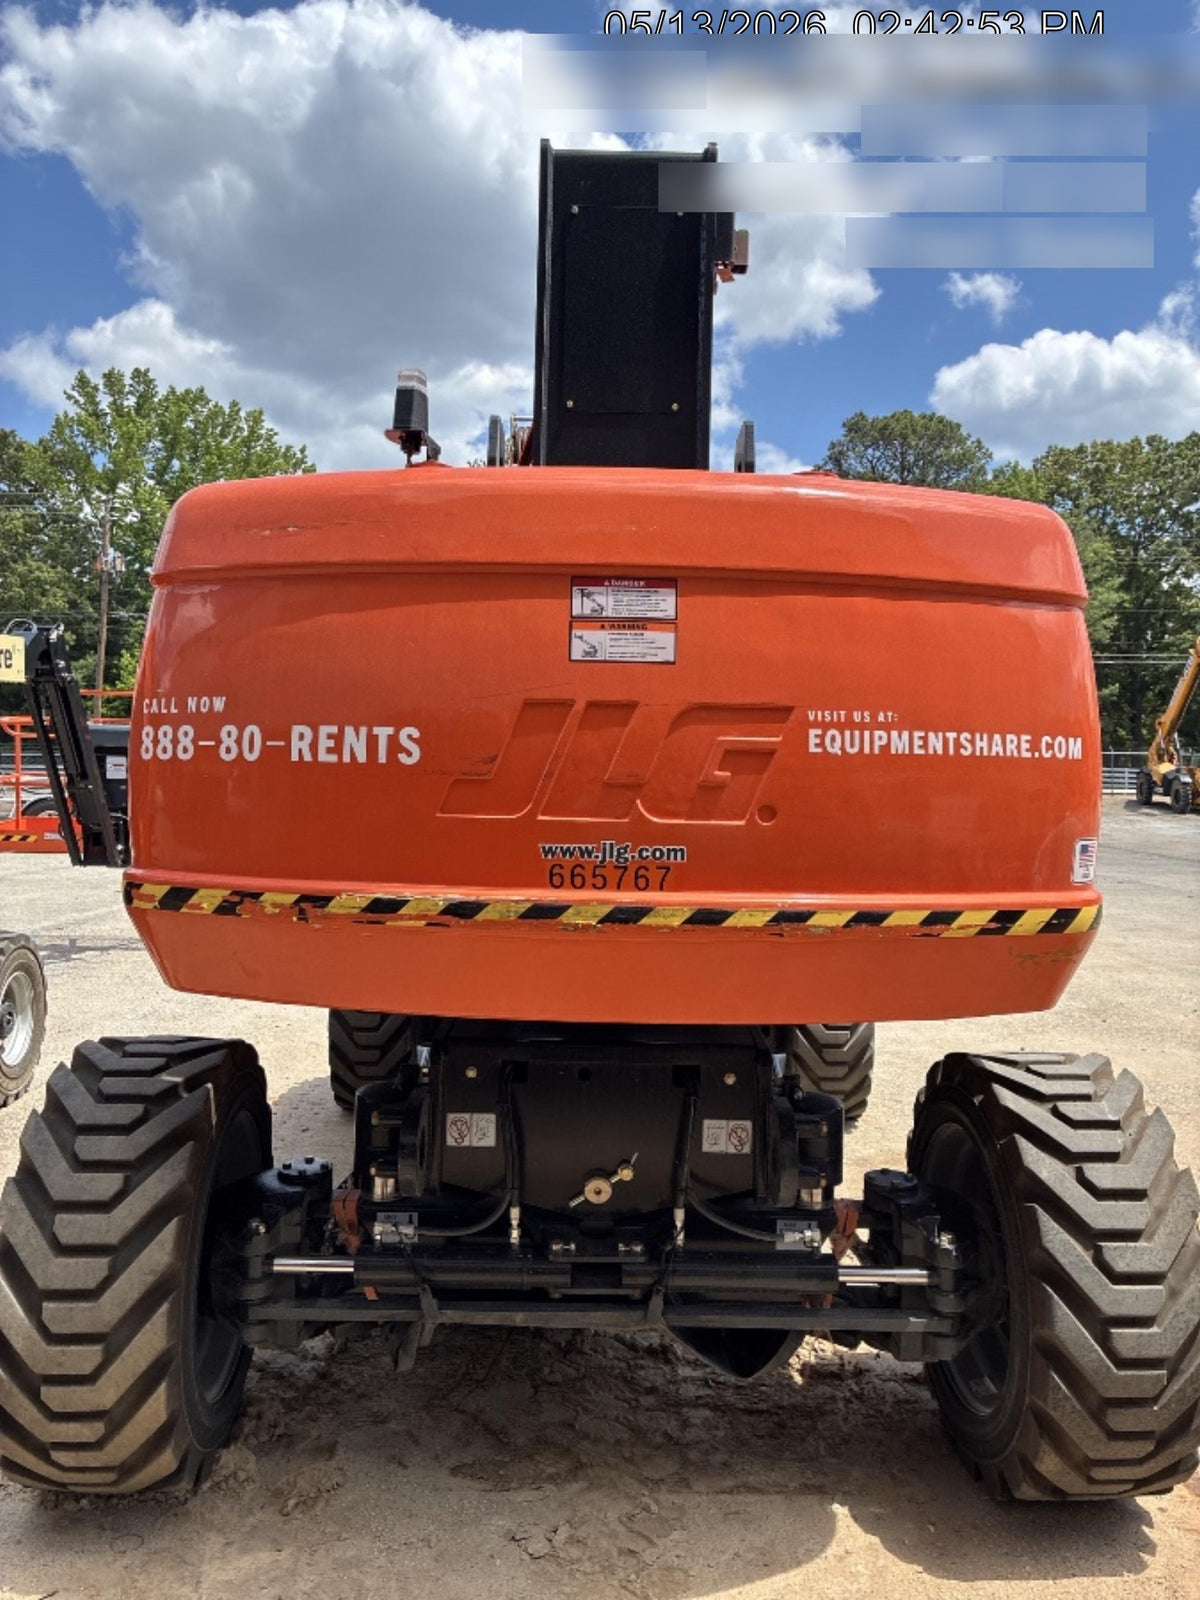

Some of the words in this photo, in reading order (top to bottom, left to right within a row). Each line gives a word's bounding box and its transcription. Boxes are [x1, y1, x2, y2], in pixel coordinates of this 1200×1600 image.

[143, 697, 178, 714] CALL
[187, 696, 226, 713] NOW
[808, 710, 847, 722] VISIT
[853, 711, 871, 722] US
[140, 724, 421, 765] 888-80-RENTS
[808, 728, 1082, 760] EQUIPMENTSHARE.COM
[539, 840, 687, 865] www.jlg.com
[548, 863, 672, 891] 665767
